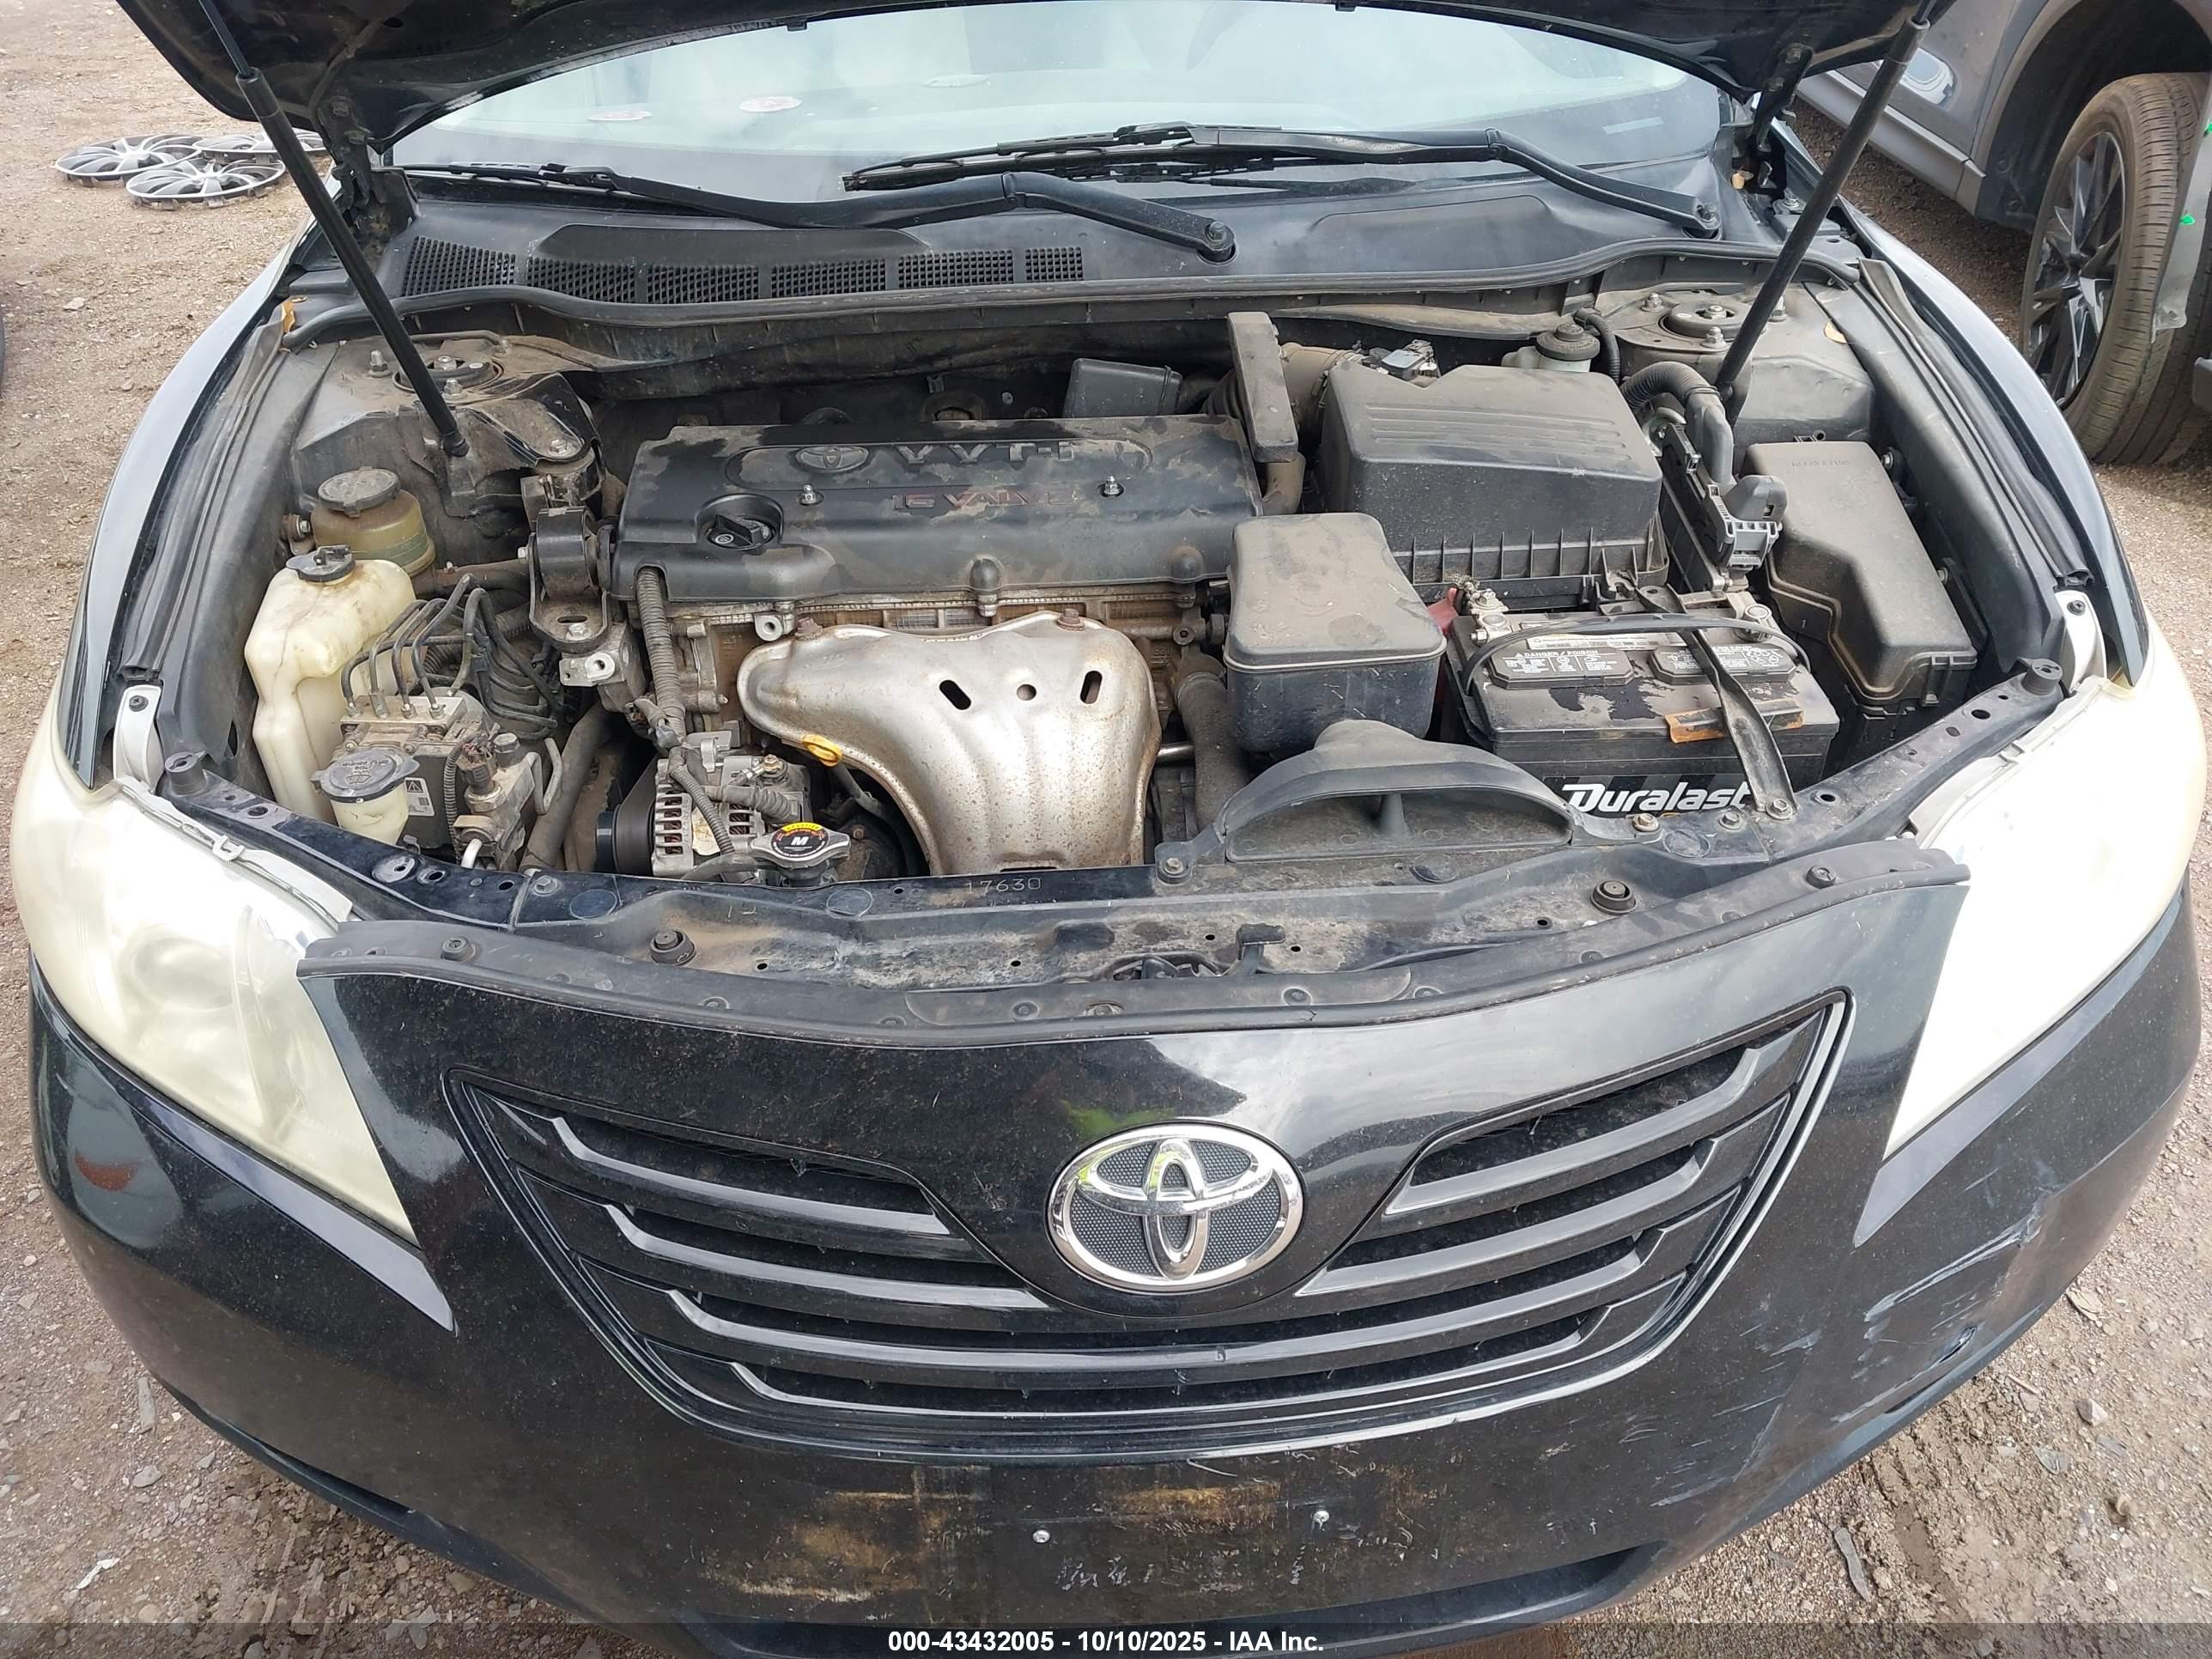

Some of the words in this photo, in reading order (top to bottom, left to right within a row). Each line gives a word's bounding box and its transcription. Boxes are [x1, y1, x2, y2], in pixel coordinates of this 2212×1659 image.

[895, 441, 1073, 465] VVT-i
[1524, 650, 1559, 659] DANGER
[1561, 781, 1752, 812] Duralast
[964, 878, 1042, 896] 17630
